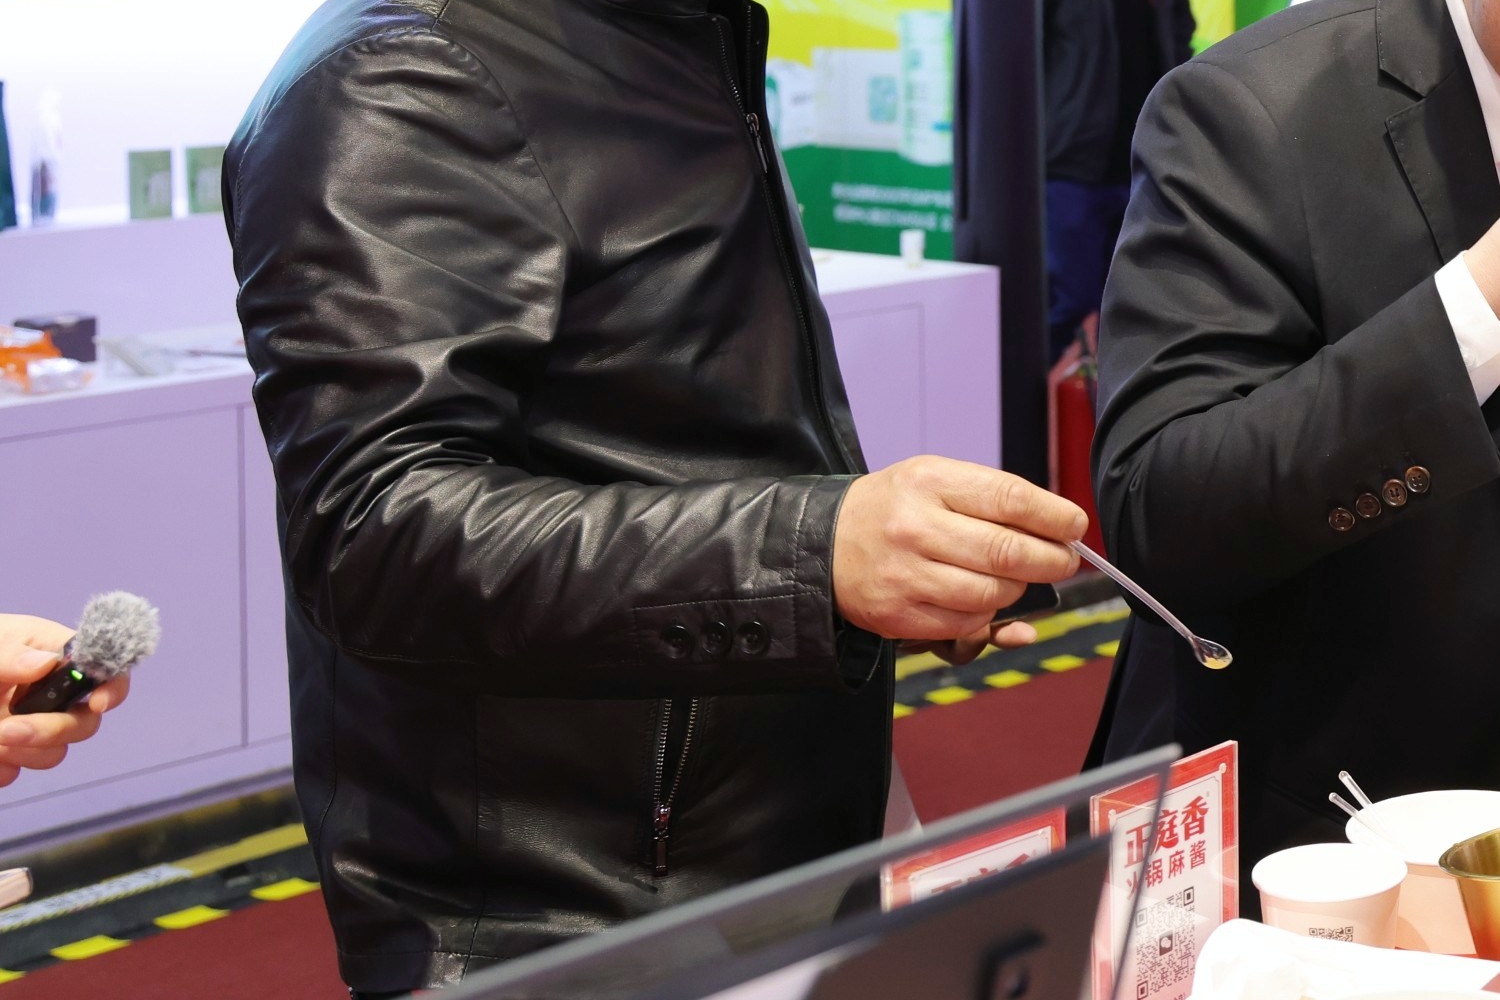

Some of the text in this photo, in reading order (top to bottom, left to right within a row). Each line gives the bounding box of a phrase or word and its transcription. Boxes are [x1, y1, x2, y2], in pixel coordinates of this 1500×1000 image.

[1124, 794, 1209, 868] 正庭香
[1125, 840, 1207, 901] 火锅麻酱
